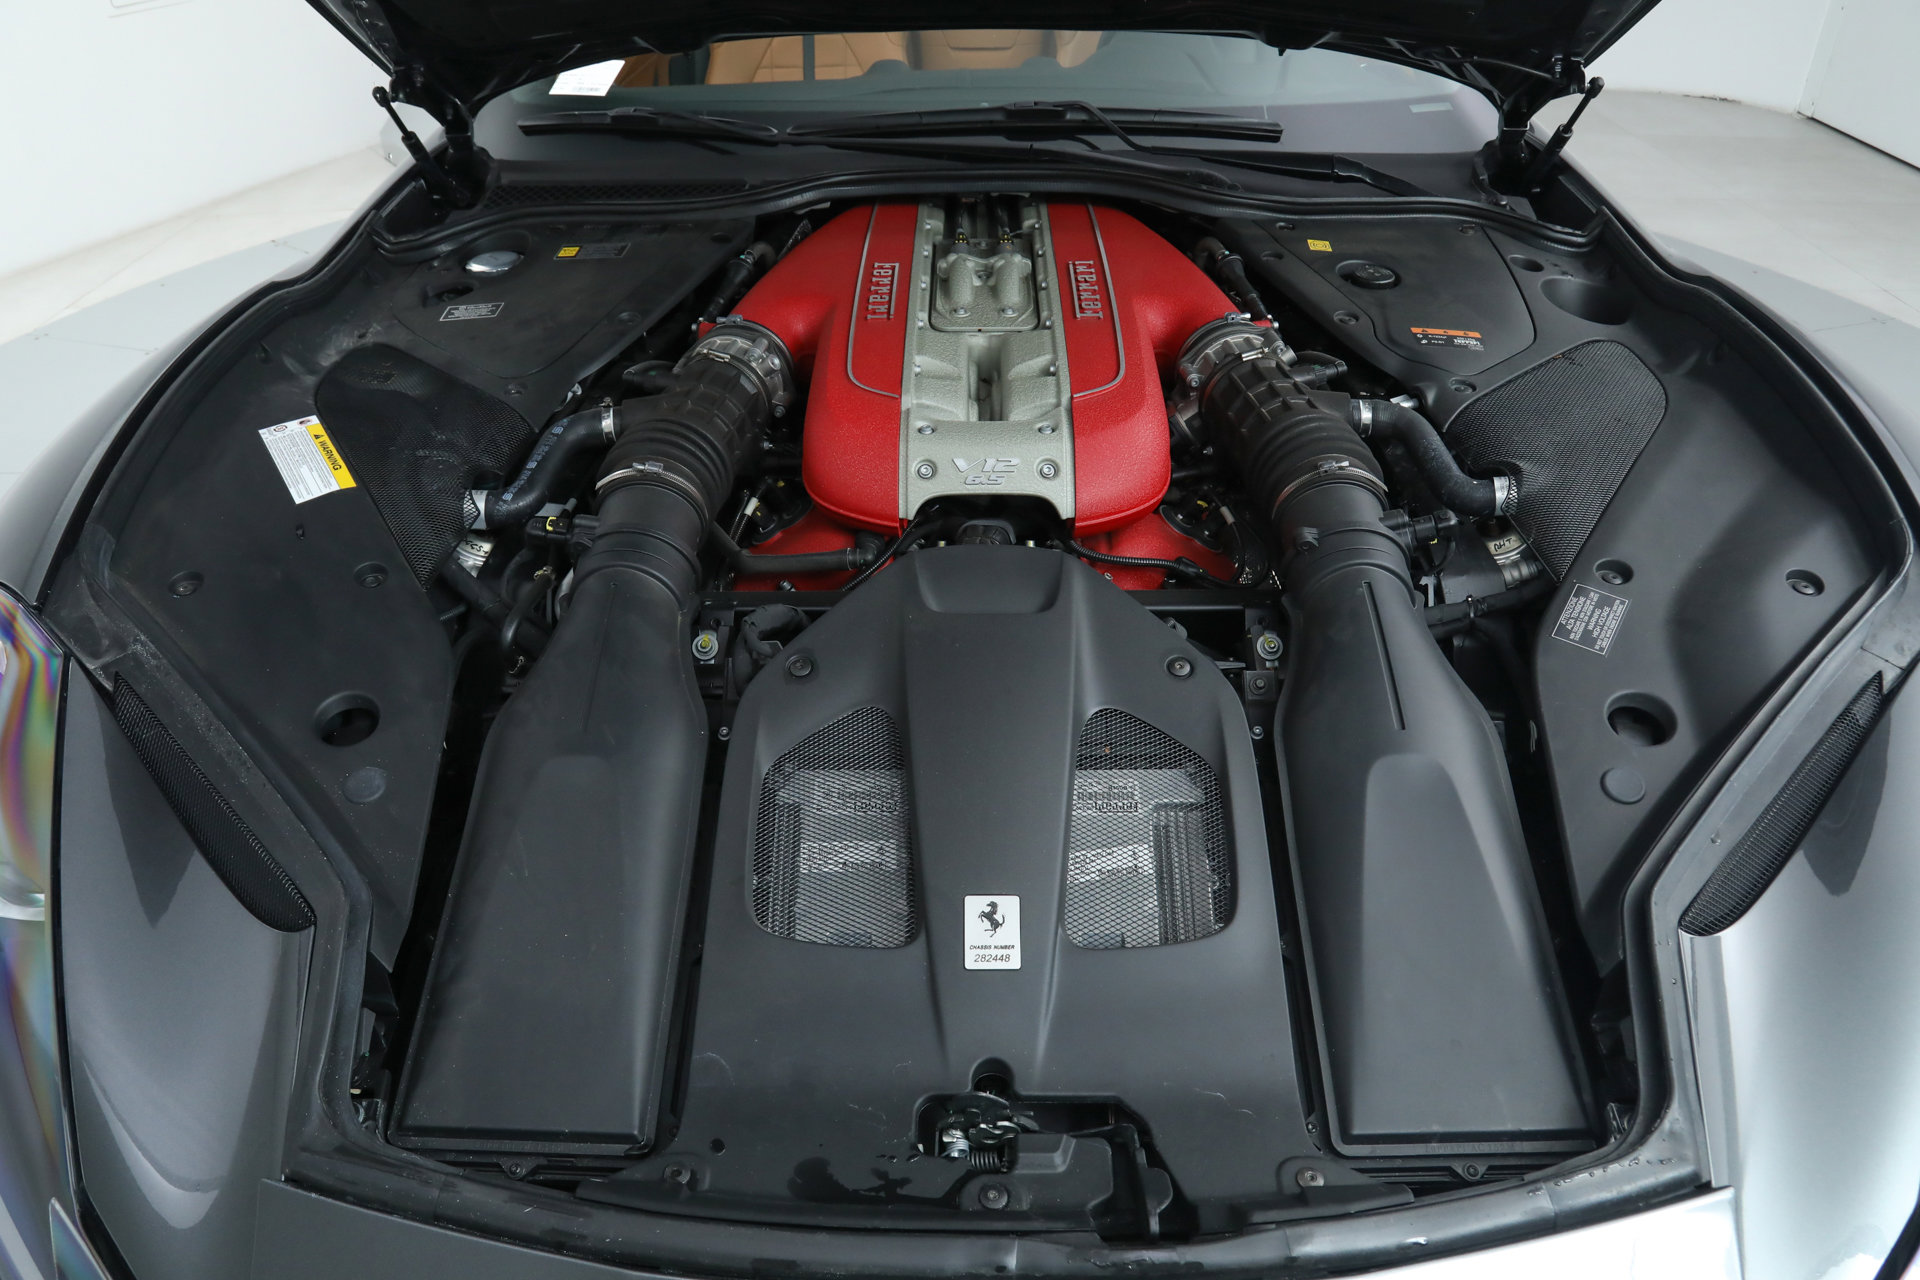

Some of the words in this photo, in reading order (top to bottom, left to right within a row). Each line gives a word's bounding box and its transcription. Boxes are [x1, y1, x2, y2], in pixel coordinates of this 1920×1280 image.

[867, 262, 900, 320] Ferrari
[1068, 260, 1104, 320] Ferrari
[318, 439, 342, 471] WARNING
[952, 458, 1021, 473] V12
[964, 474, 1007, 486] 6.5
[974, 953, 1011, 963] 282448
